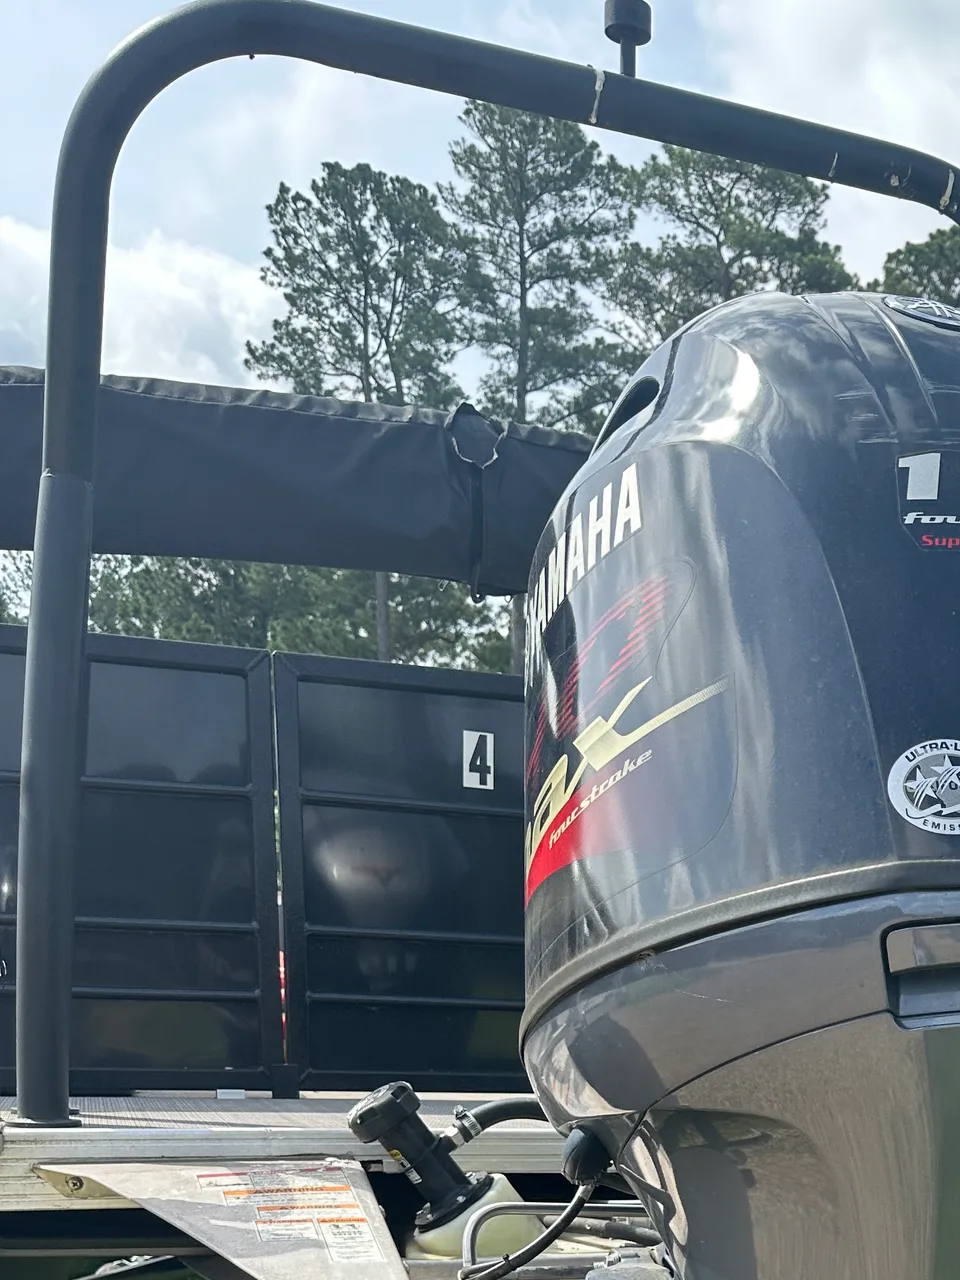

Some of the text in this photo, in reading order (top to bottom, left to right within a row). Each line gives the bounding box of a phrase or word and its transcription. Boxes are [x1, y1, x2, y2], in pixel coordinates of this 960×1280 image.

[529, 462, 643, 686] YAMAHA
[469, 734, 491, 786] 4
[549, 749, 653, 851] fourstroke
